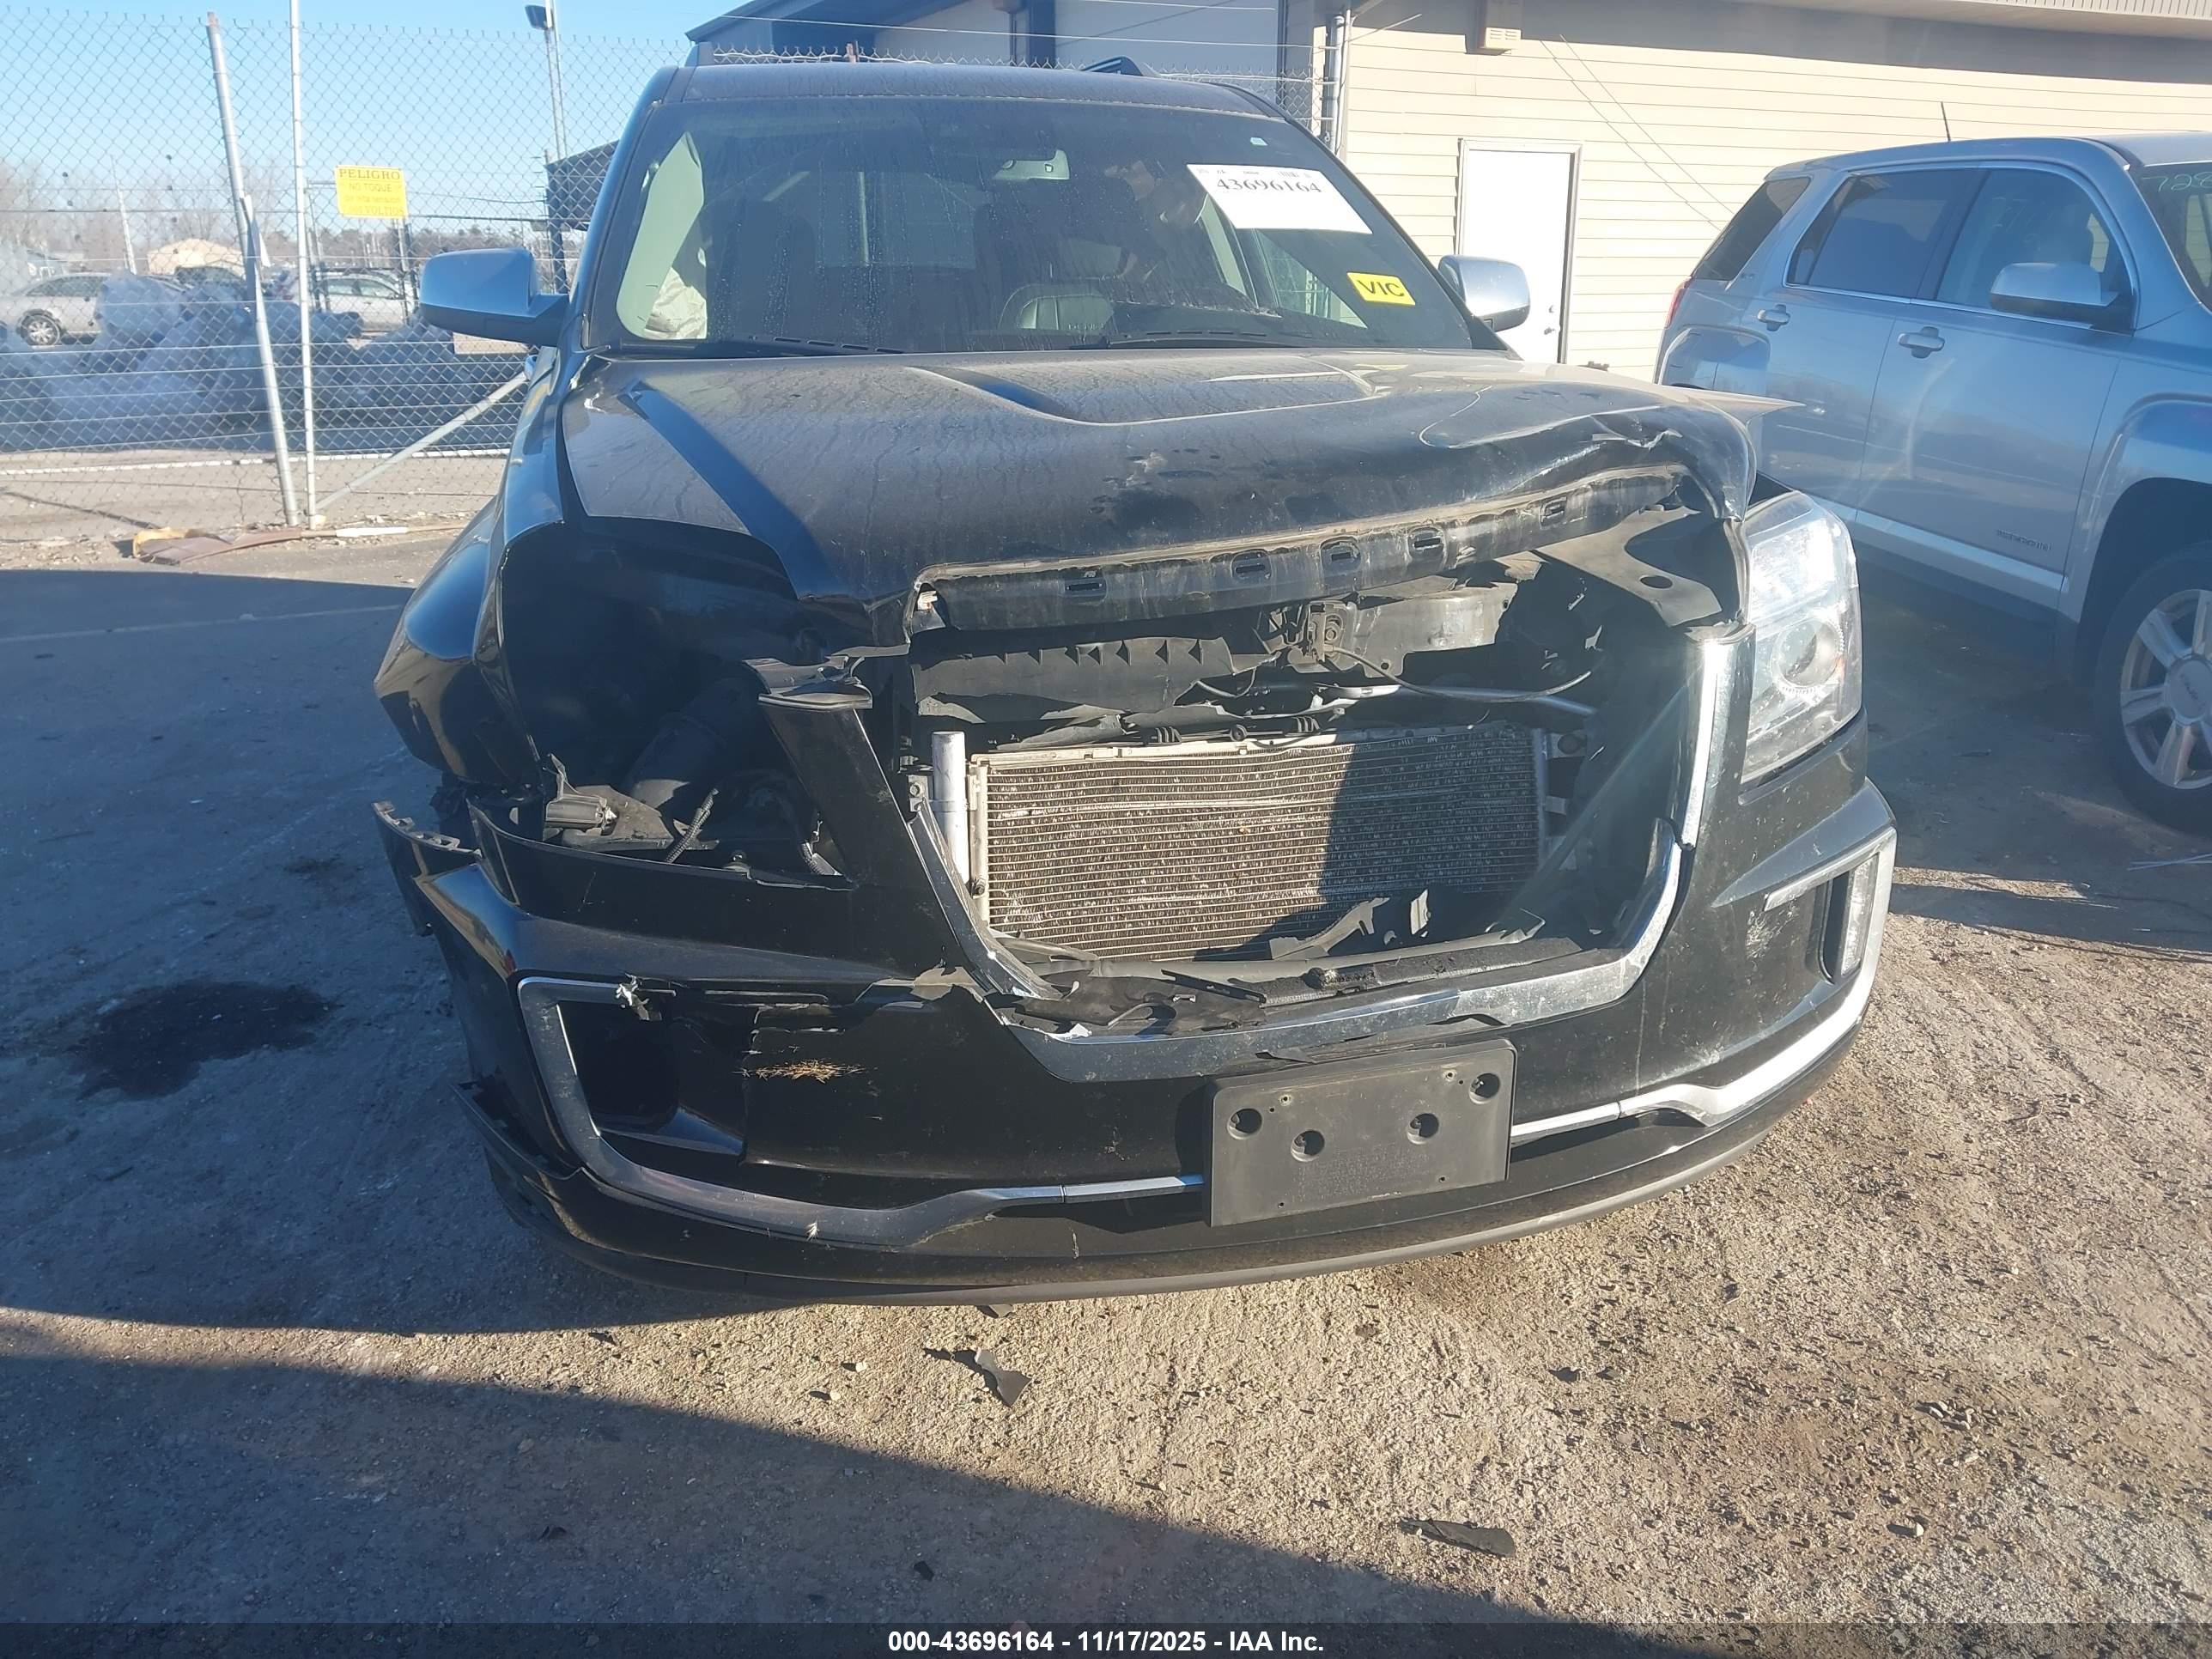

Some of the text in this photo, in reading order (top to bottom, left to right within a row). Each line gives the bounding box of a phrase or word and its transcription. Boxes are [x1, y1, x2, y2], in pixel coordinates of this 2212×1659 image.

[339, 168, 400, 180] PELIGRO
[364, 183, 392, 192] TOQUE
[1217, 179, 1322, 193] 43696164
[1357, 280, 1405, 297] VIC
